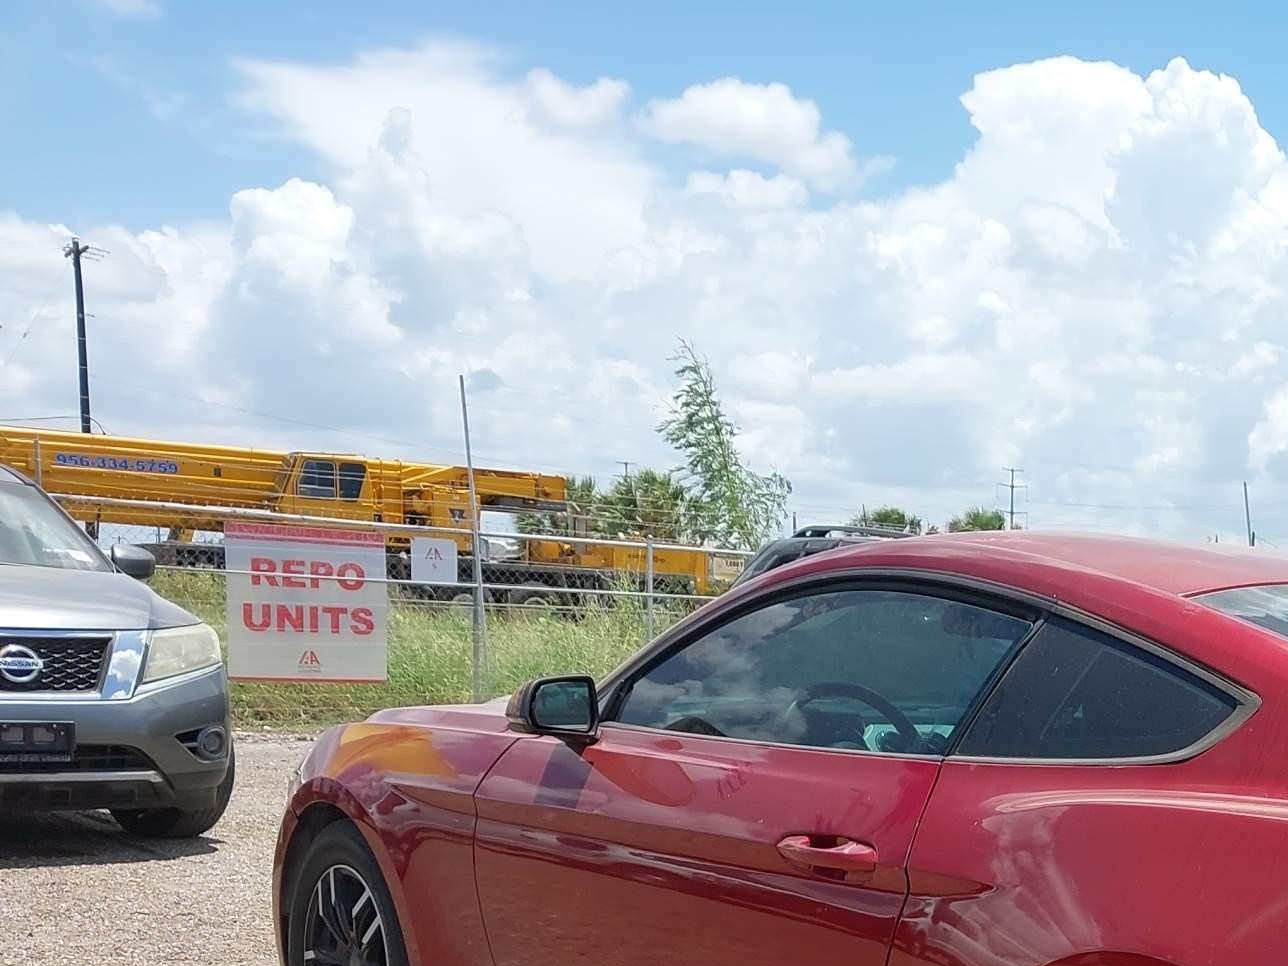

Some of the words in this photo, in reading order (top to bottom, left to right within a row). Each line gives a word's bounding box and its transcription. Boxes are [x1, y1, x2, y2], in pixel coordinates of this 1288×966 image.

[56, 453, 178, 474] 956-334-5759
[250, 557, 365, 591] REPO
[242, 602, 375, 636] UNITS
